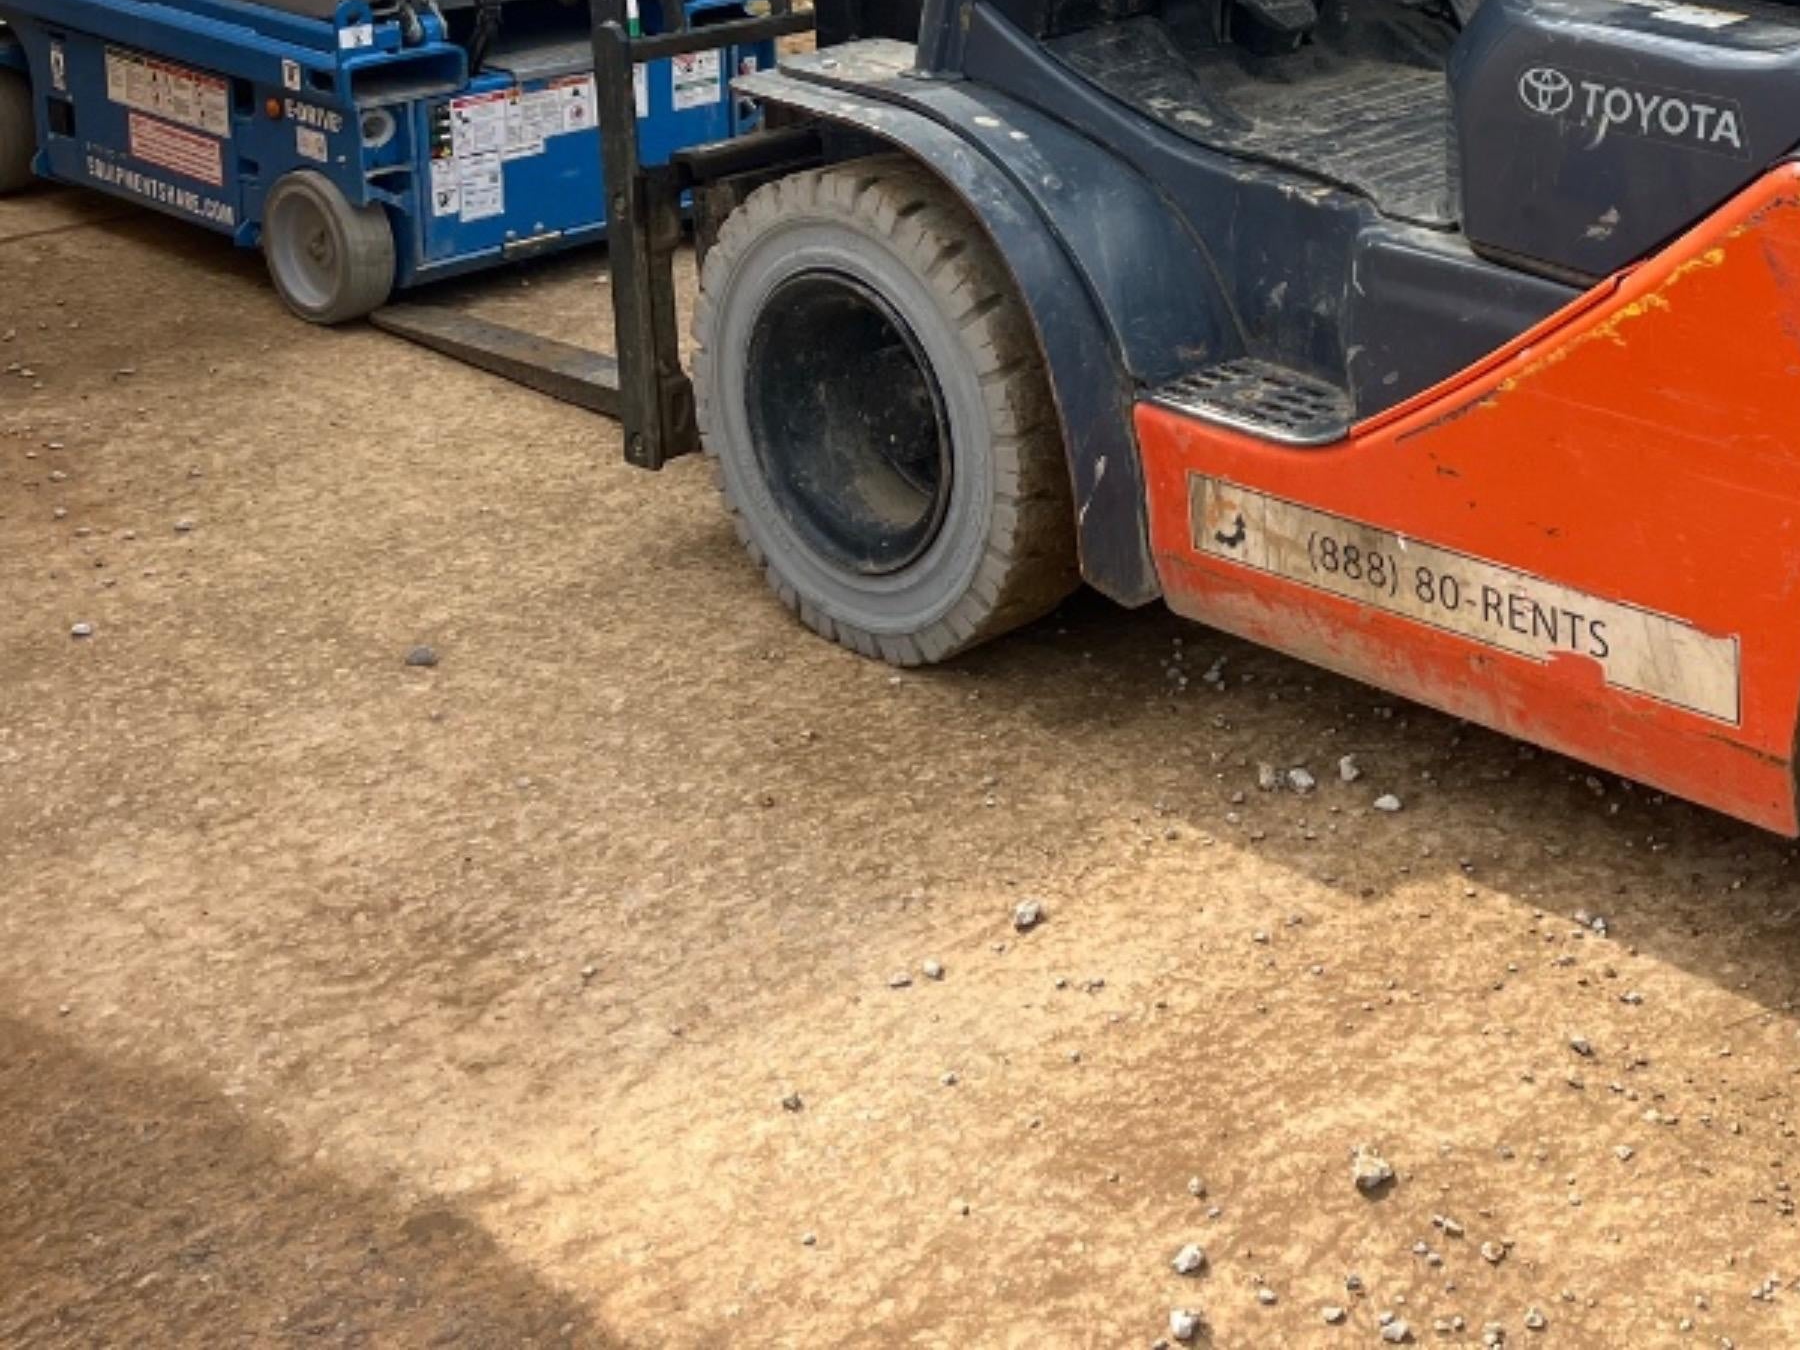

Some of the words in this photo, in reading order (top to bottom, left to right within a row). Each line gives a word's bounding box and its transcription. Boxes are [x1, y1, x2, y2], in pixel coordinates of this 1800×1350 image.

[1581, 81, 1741, 148] TOYOTA
[1306, 529, 1400, 600] (888)
[1414, 567, 1611, 659] 80-RENTS
